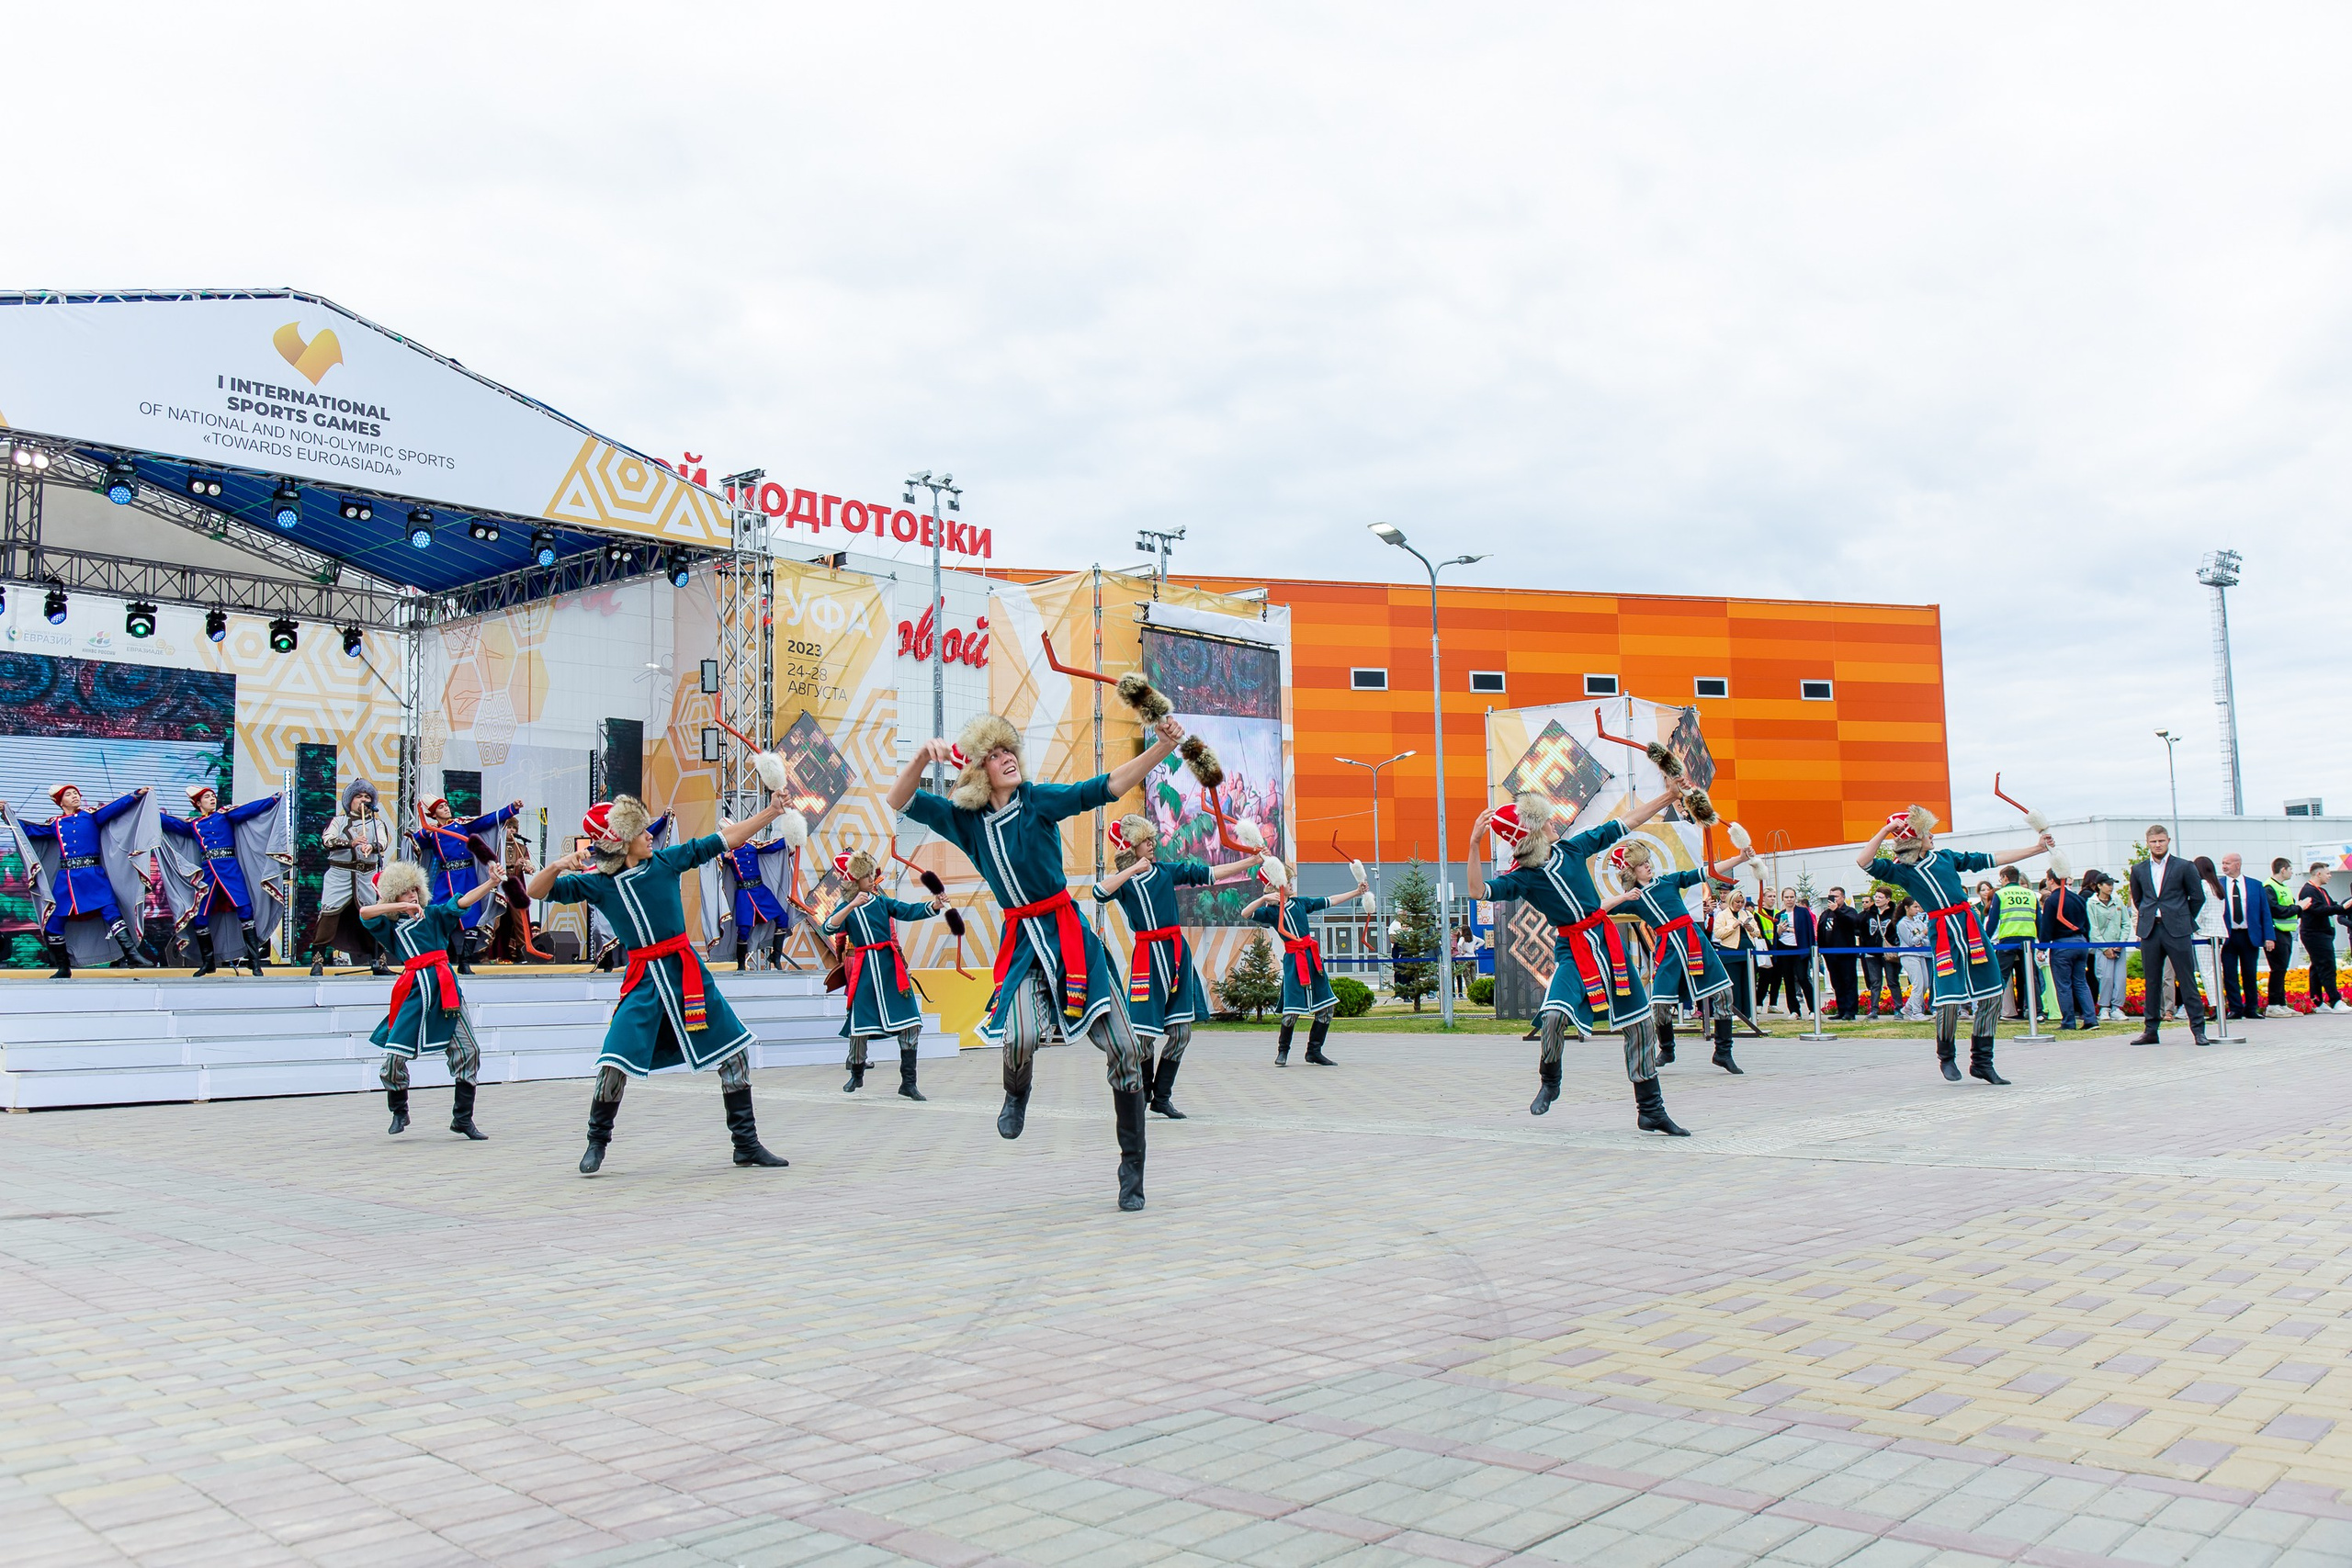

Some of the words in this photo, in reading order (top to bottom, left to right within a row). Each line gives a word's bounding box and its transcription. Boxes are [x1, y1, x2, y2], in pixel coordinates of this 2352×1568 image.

[218, 374, 223, 389] I
[231, 378, 390, 422] INTERNATIONAL
[227, 396, 307, 423] SPORTS
[313, 414, 381, 437] GAMES
[139, 401, 163, 416] OF
[168, 406, 248, 433] NATIONAL
[253, 423, 285, 439] AND
[290, 428, 393, 458] NON-OLYMPIC
[398, 448, 455, 469] SPORTS
[203, 432, 292, 457] «TOWARDS
[297, 447, 401, 477] EUROASIADA»
[785, 588, 873, 638] УФА
[24, 633, 72, 646] ЕВРАЗИИ
[787, 639, 822, 658] 2023
[787, 662, 828, 681] 24-28
[787, 680, 848, 702] АВГУСТА
[2007, 897, 2030, 905] 302
